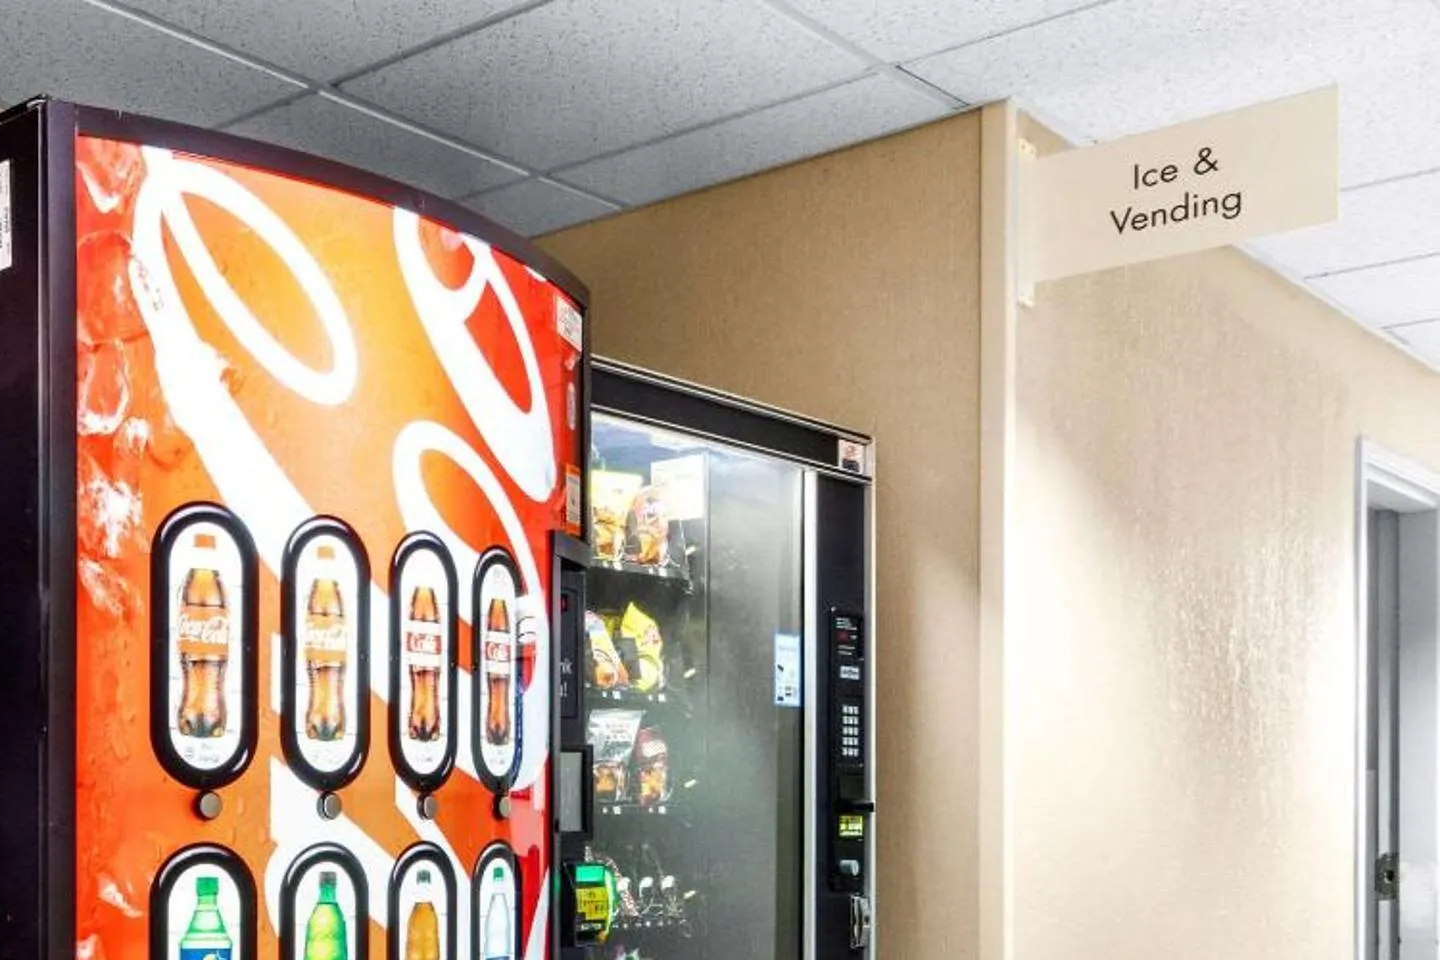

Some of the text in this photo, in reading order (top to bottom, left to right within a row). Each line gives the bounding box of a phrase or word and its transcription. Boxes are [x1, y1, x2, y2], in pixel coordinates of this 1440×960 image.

[1134, 147, 1219, 189] Ice &
[1111, 192, 1241, 234] Vending
